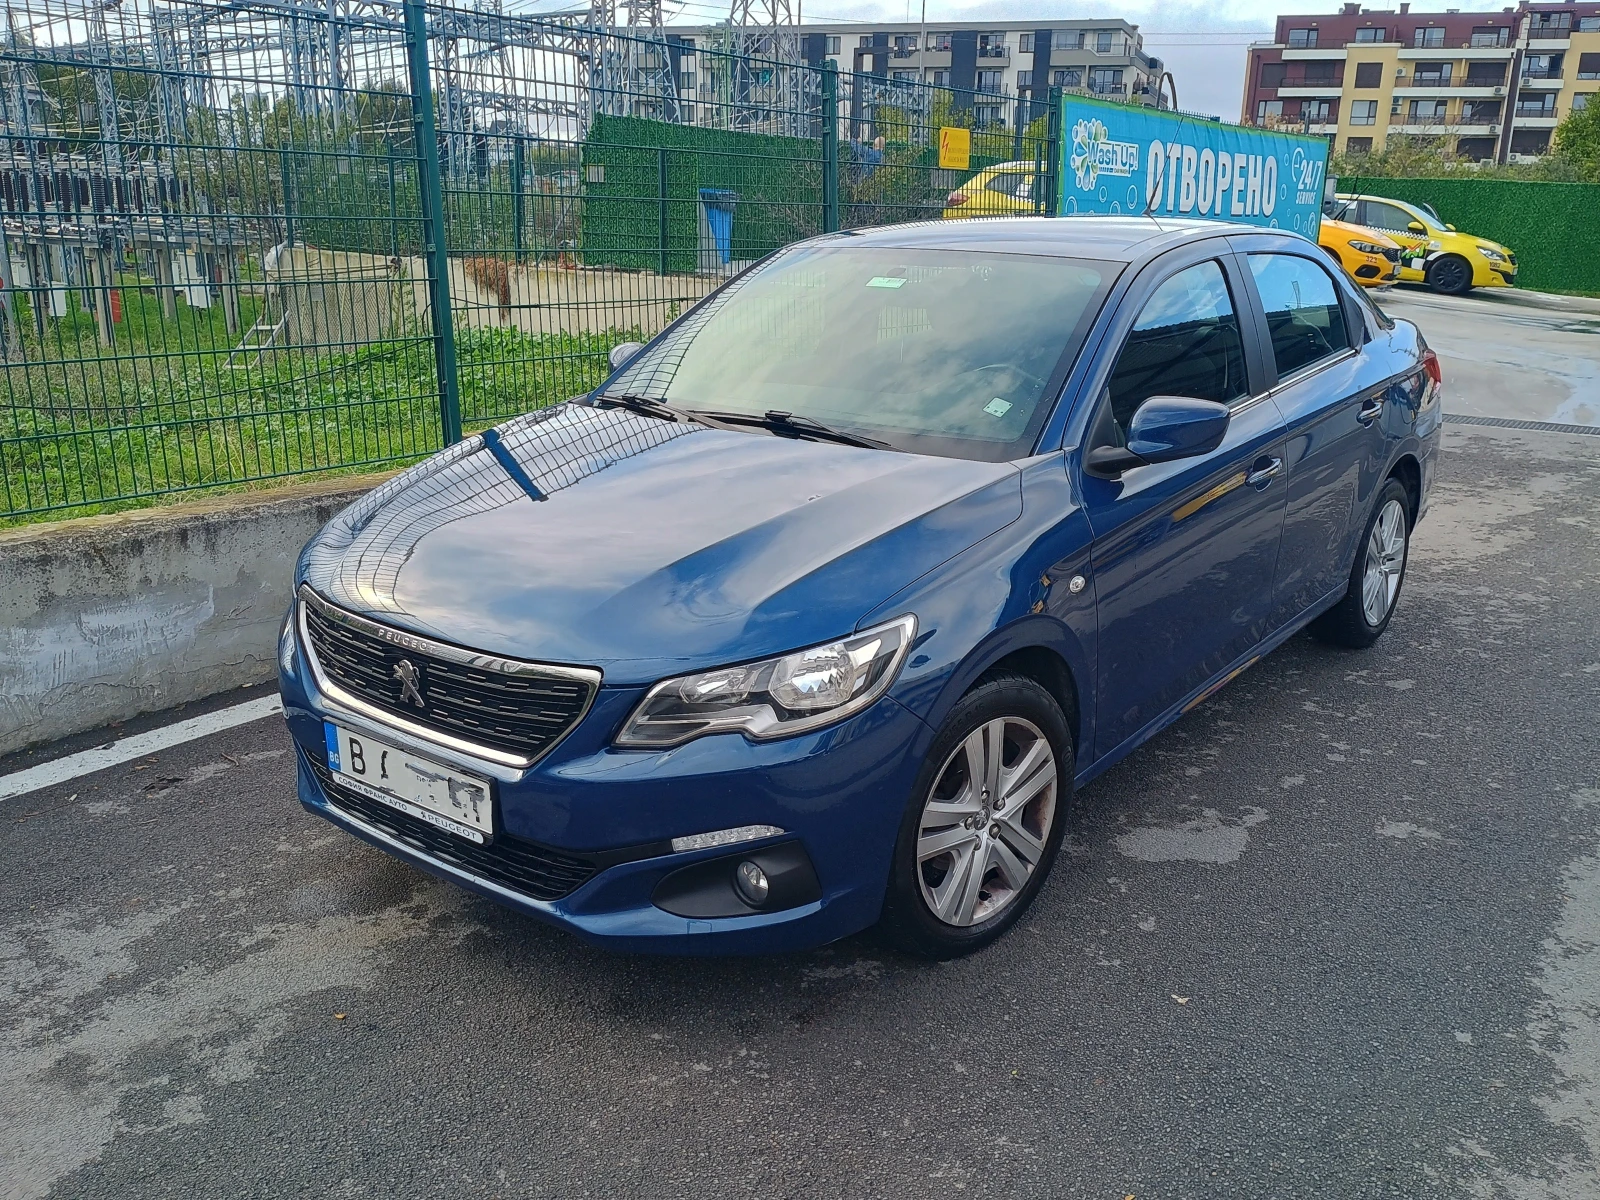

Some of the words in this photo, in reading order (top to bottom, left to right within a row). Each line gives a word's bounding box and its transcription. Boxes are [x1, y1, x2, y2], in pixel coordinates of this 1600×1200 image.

[1087, 141, 1118, 166] Wash
[1121, 145, 1138, 175] Up!
[1146, 139, 1277, 216] ОТВОРЕНО
[1297, 159, 1323, 190] 24/7
[1295, 191, 1316, 205] SERVICE
[1365, 255, 1378, 264] 323
[378, 628, 437, 653] PEUGEOT
[329, 750, 340, 764] BG
[338, 776, 363, 792] СОФИЯ
[363, 788, 388, 803] ФРАНС
[389, 798, 408, 811] АУТО
[427, 814, 477, 840] PEUGEOT
